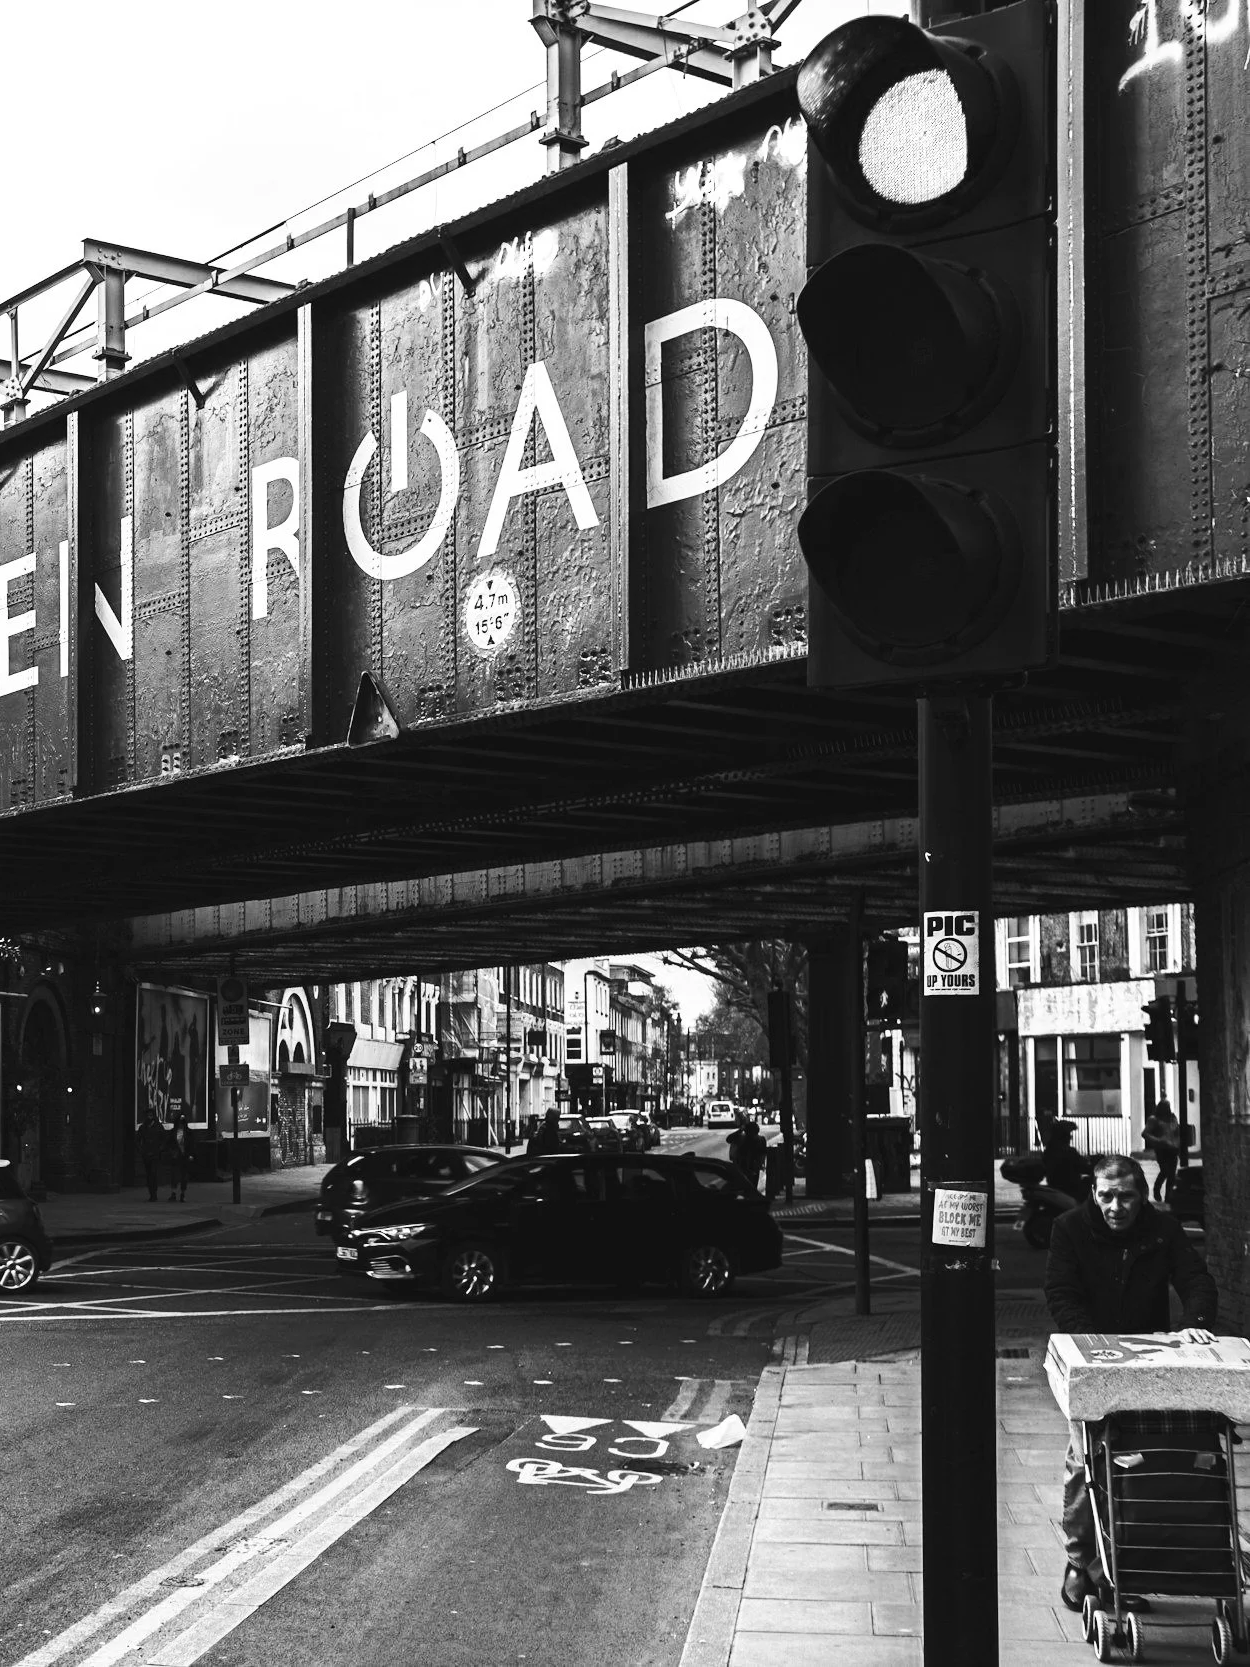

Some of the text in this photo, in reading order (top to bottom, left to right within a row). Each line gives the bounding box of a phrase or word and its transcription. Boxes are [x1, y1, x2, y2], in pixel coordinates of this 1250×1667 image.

[250, 297, 779, 621] ROAD
[474, 593, 508, 611] 4.7m
[928, 916, 975, 937] PIC
[927, 974, 975, 987] UP YOURS
[950, 1201, 959, 1210] MY
[962, 1203, 983, 1212] WORST
[939, 1211, 981, 1226] BLOCK ME
[951, 1227, 959, 1237] MY
[961, 1228, 975, 1237] BEST
